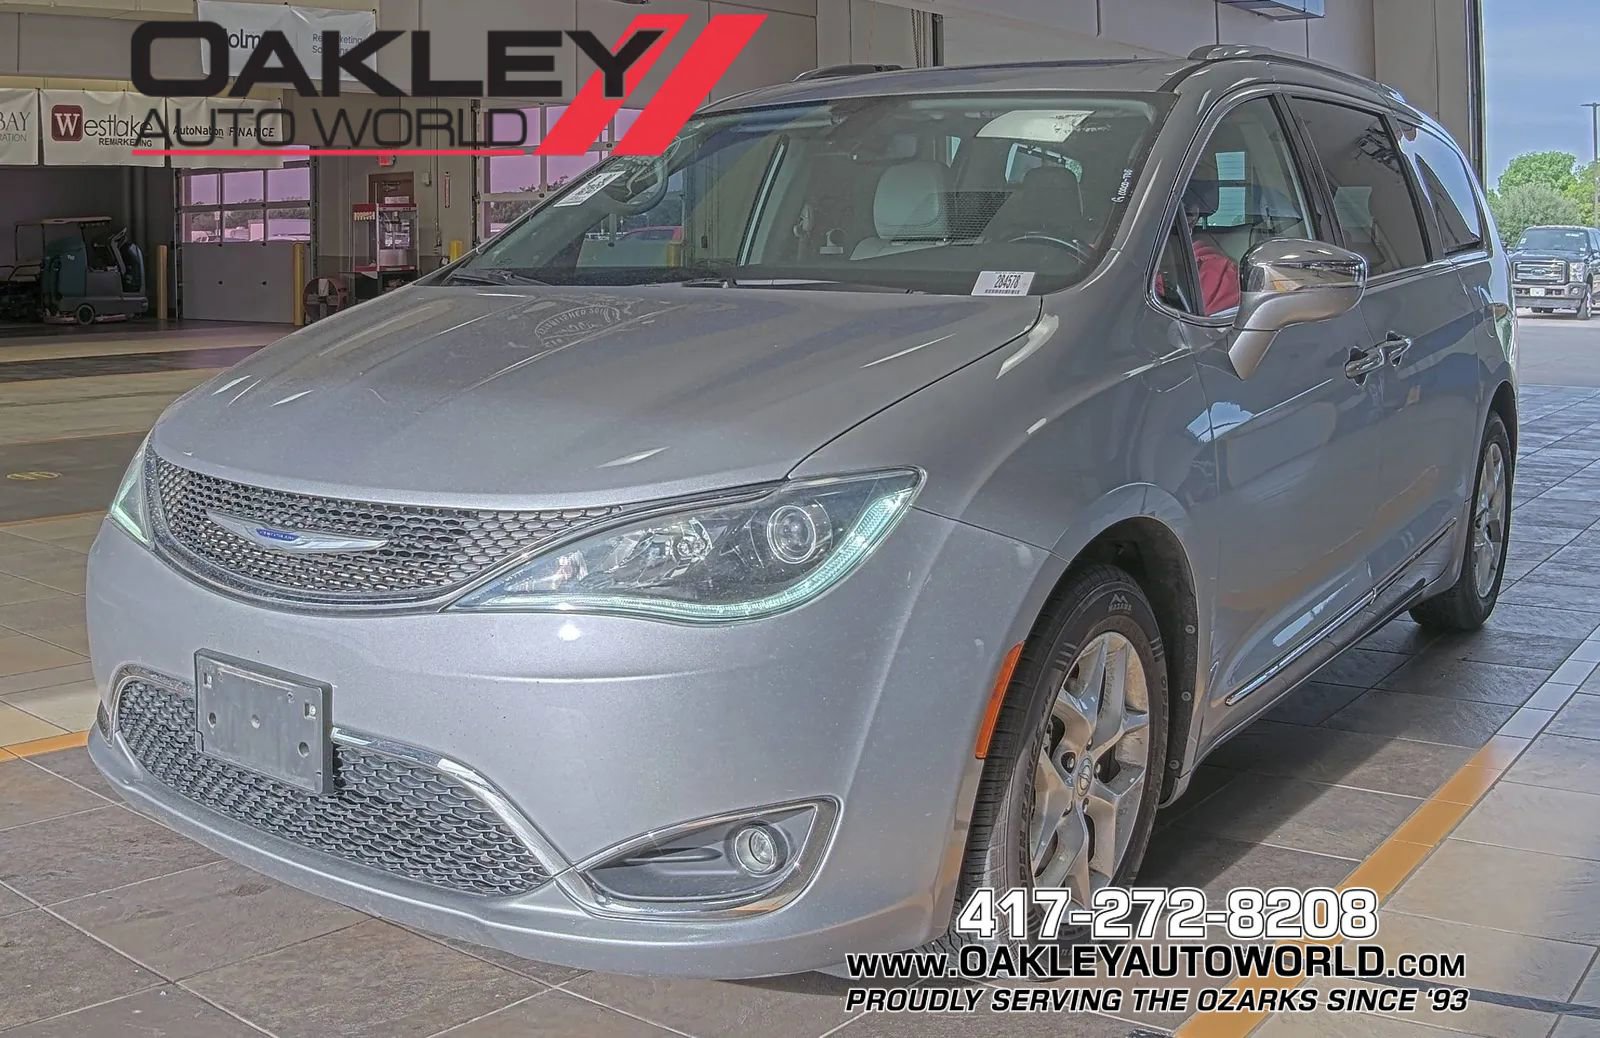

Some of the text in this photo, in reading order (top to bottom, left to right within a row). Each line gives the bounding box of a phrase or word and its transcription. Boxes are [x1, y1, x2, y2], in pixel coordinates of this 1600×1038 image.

[54, 113, 153, 137] Westlake
[173, 125, 275, 137] AutoNaton FNANCE
[99, 137, 153, 147] REMARKEING
